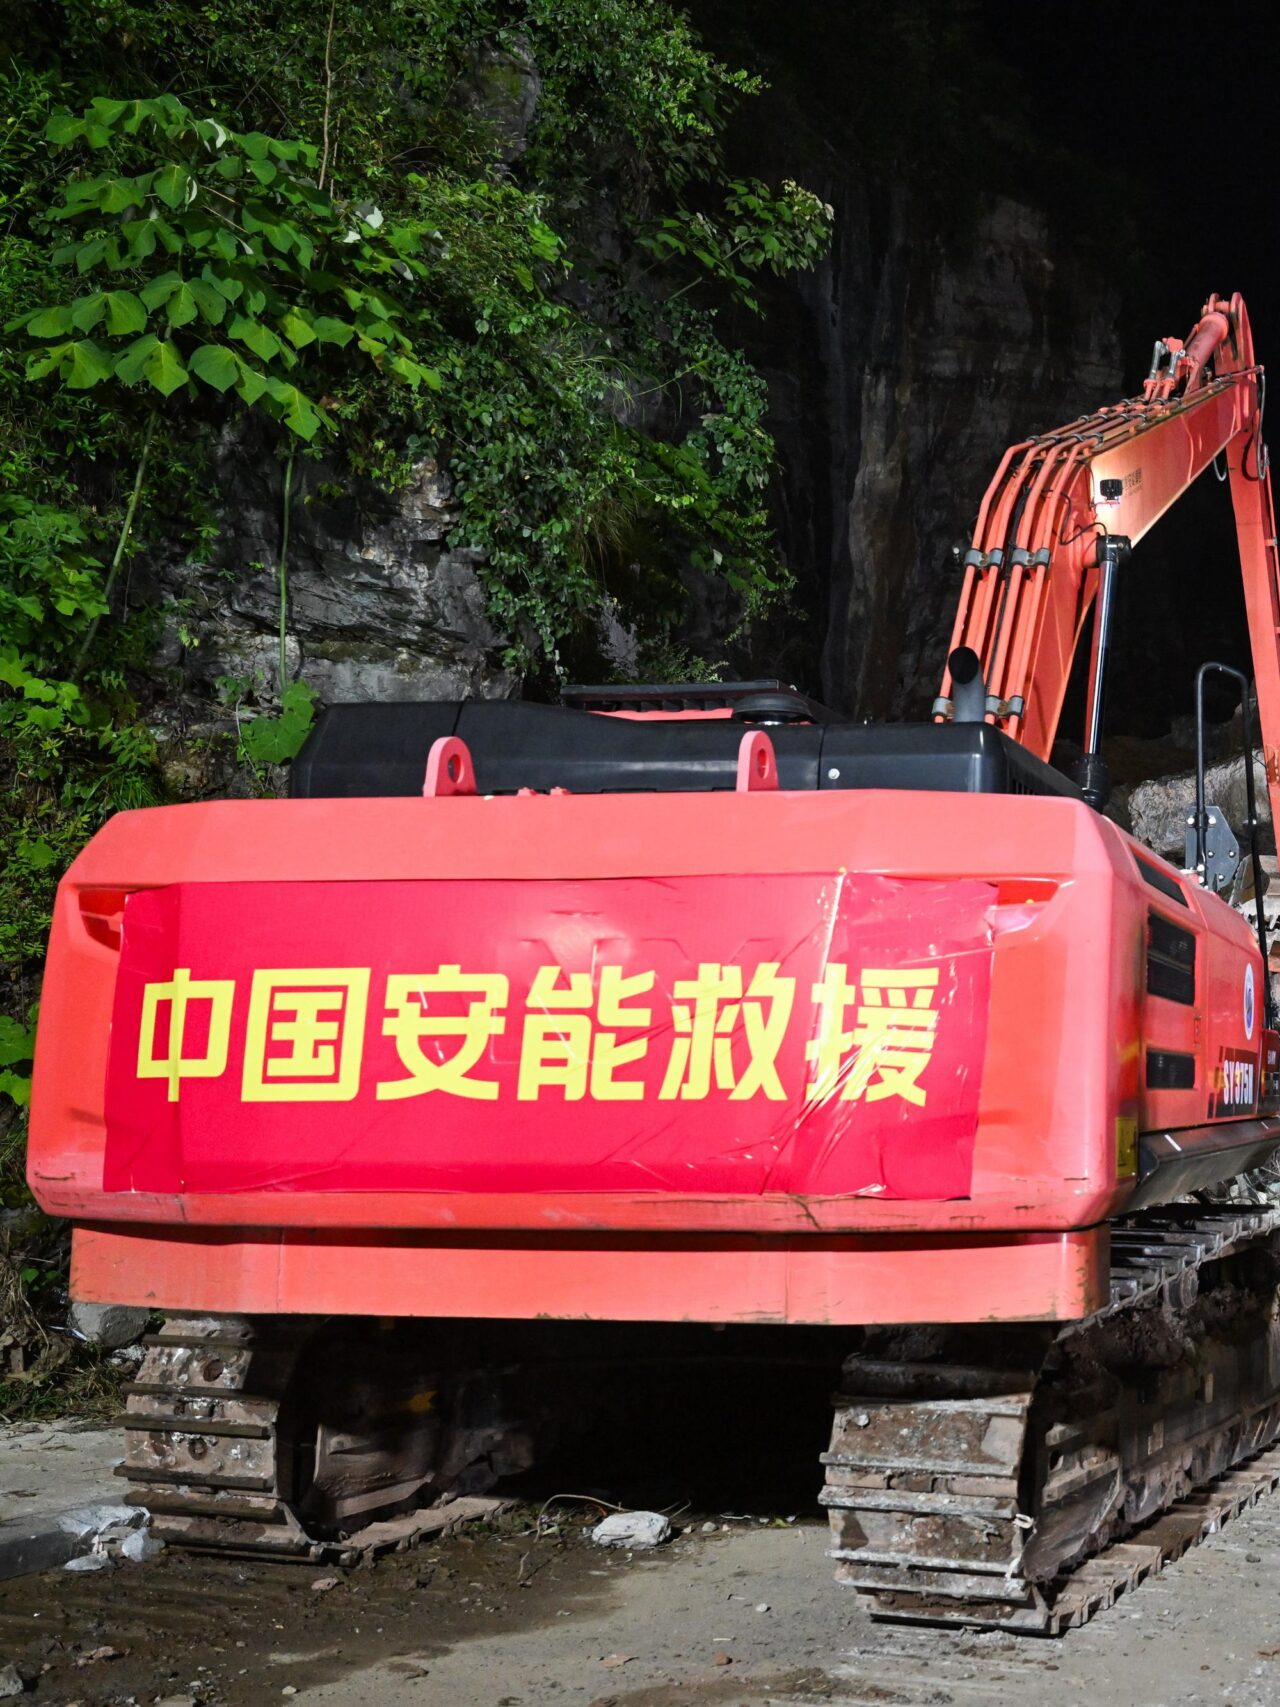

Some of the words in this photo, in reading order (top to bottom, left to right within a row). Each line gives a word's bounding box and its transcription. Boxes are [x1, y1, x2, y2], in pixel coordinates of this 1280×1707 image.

[137, 963, 940, 1107] 中国安能救援
